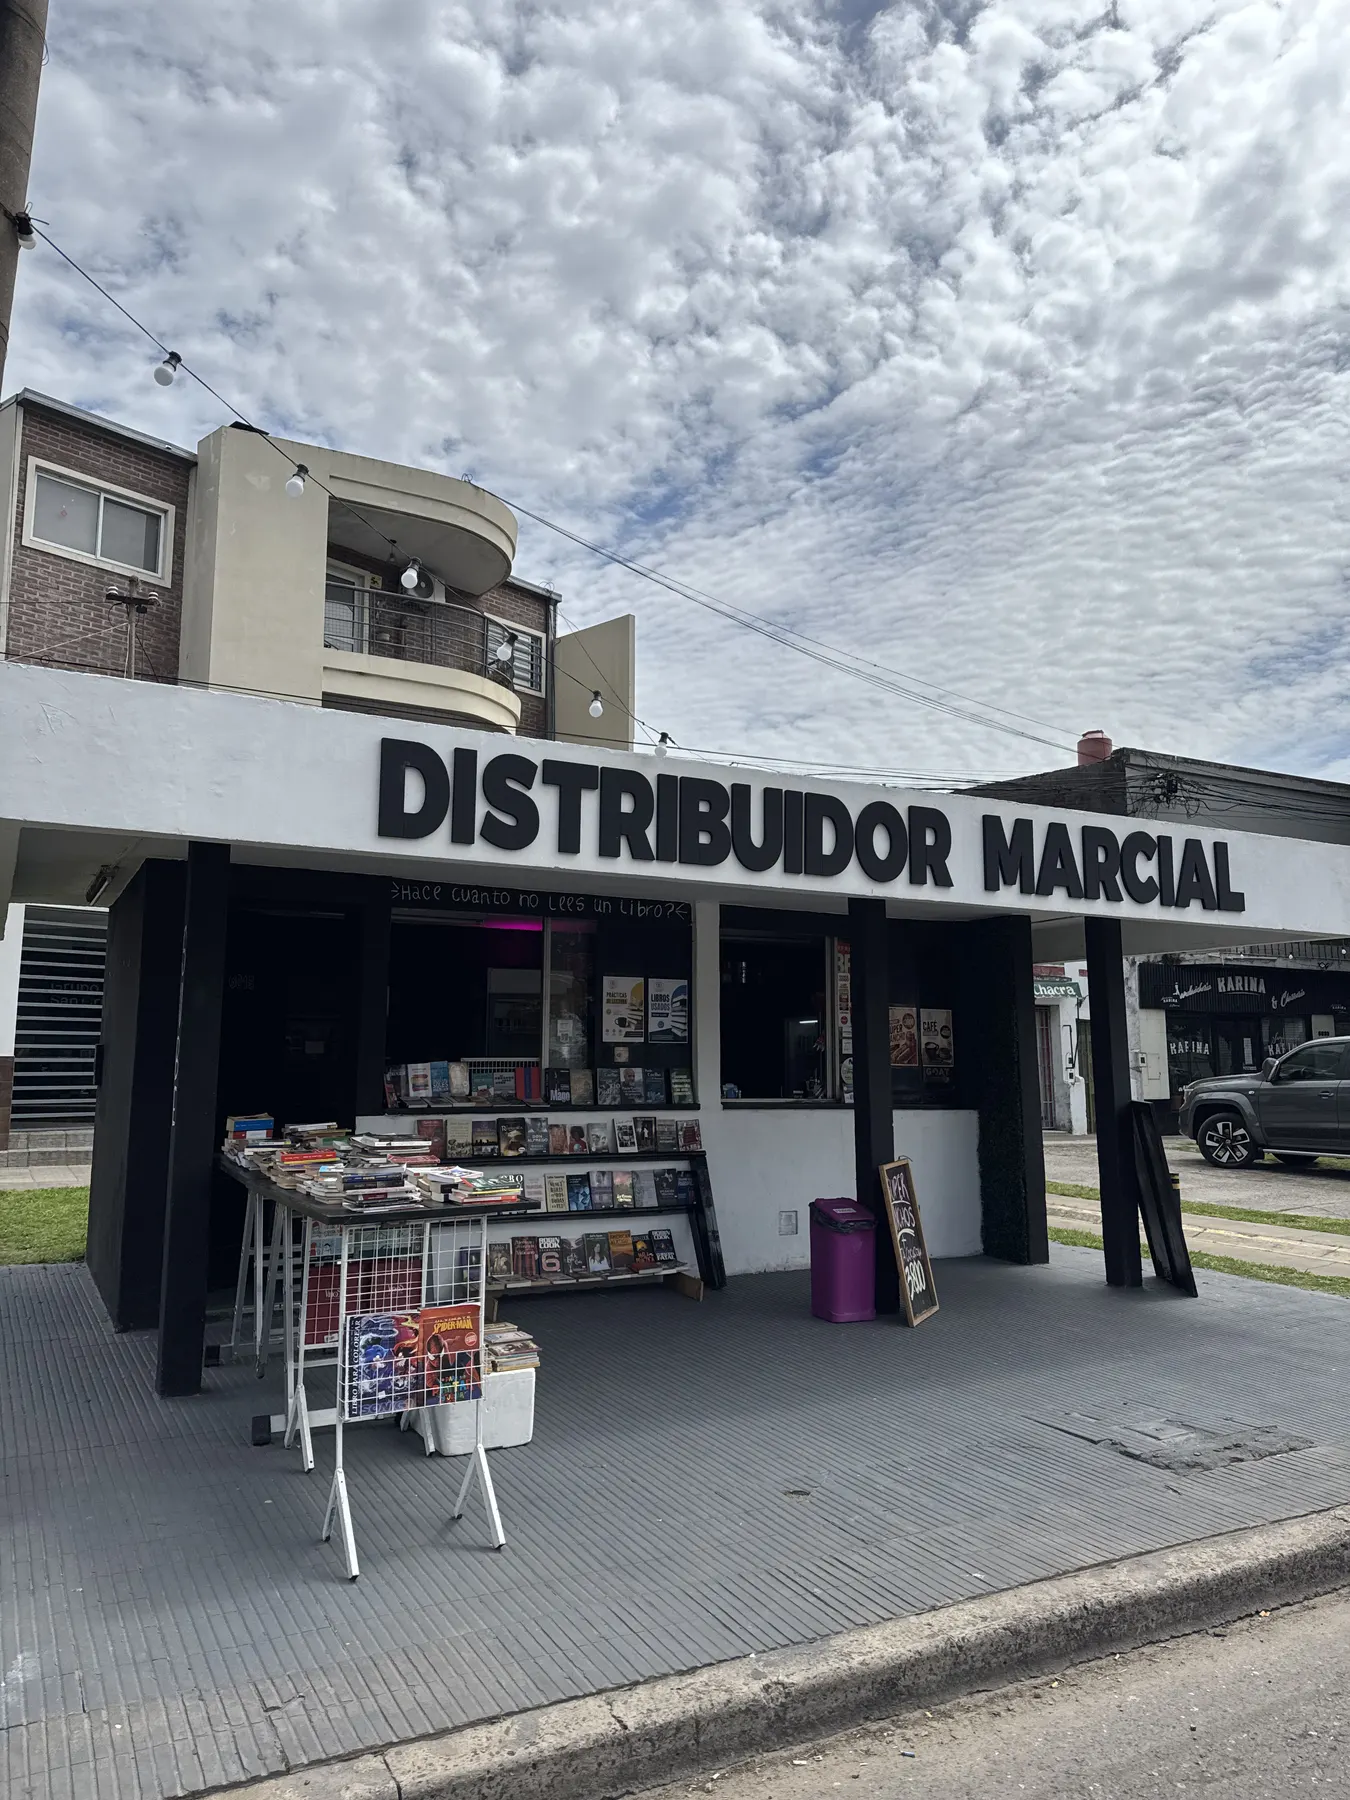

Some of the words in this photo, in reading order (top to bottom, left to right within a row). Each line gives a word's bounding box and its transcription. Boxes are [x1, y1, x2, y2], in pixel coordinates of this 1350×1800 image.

[378, 737, 954, 888] DISTRIBUIDOR
[982, 813, 1246, 913] MARCIAL
[401, 884, 442, 900] Hace
[452, 887, 511, 904] cuanto
[519, 893, 539, 908] no
[593, 898, 612, 913] un
[1216, 975, 1266, 995] KARINA
[651, 993, 670, 1003] LIBROS
[651, 1002, 671, 1011] USADOS
[922, 1020, 938, 1032] CAFÉ
[541, 1251, 561, 1272] 6
[433, 1318, 473, 1334] SPIDER-MAN
[353, 1319, 361, 1364] COLOREAR
